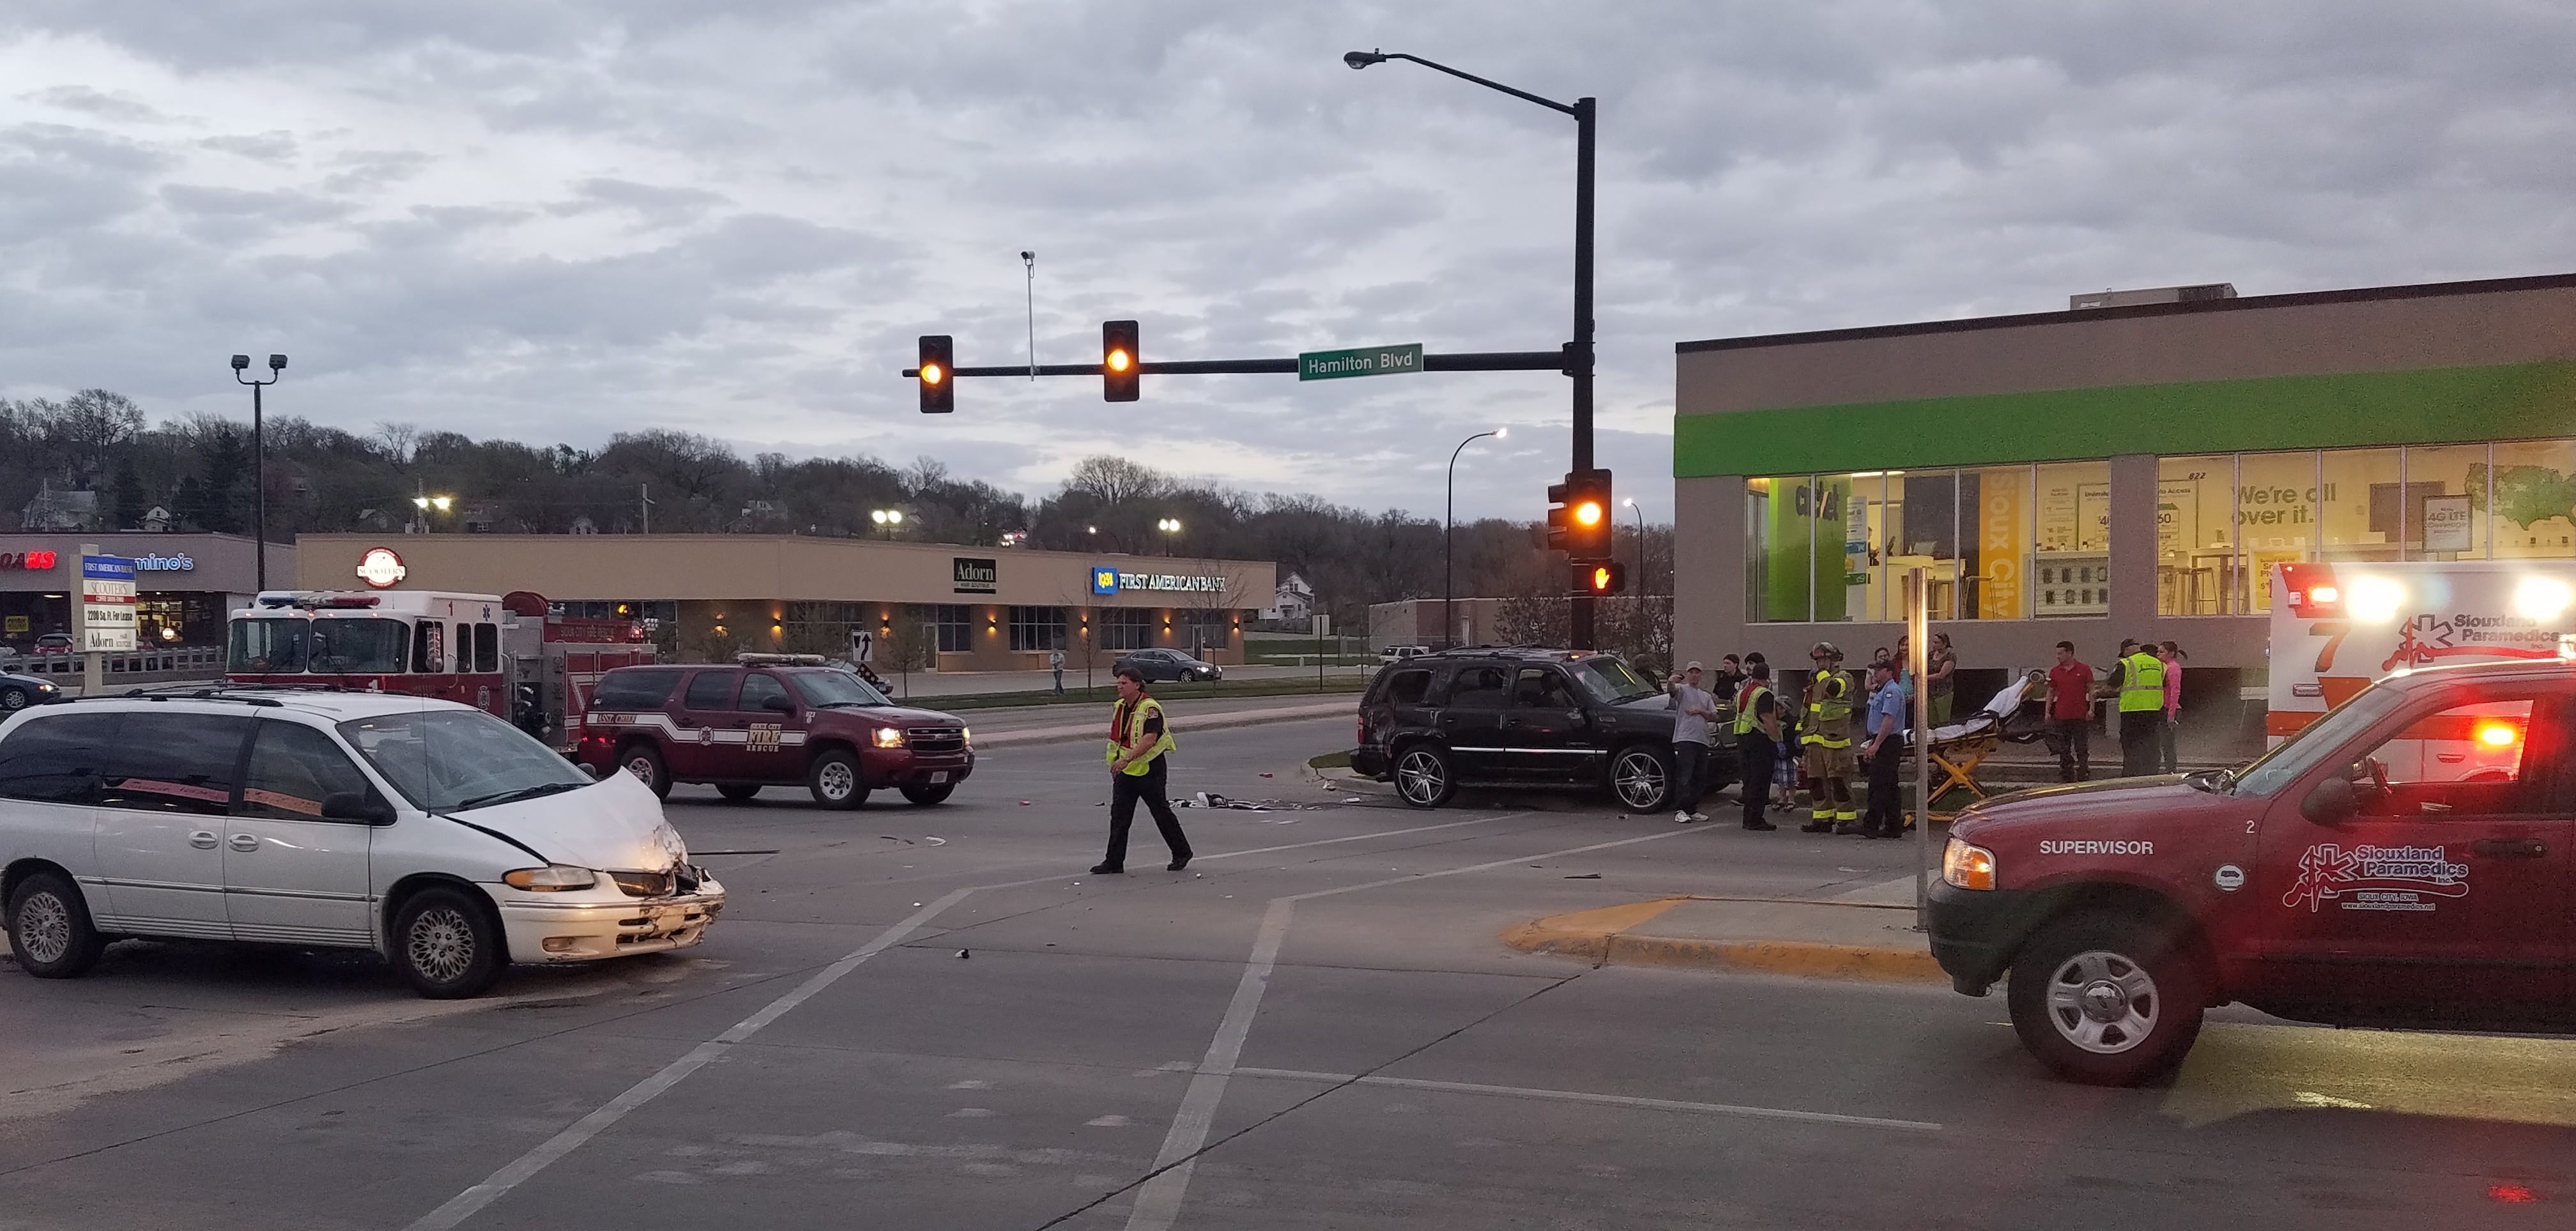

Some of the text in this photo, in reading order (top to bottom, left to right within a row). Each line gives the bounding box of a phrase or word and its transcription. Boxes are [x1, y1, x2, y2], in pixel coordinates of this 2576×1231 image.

[1308, 351, 1413, 374] Hamilton Blvd
[1795, 478, 1839, 521] crcket
[2231, 482, 2336, 505] We're all
[2231, 505, 2314, 525] over it.
[2428, 511, 2466, 521] 4G LTE
[956, 562, 993, 581] Adorn
[1118, 573, 1148, 590] FIRST
[1148, 574, 1200, 592] AMERICAN
[1200, 576, 1227, 592] BANK
[88, 609, 99, 621] 2200
[120, 611, 133, 621] Lease
[448, 600, 453, 616] 1
[89, 632, 114, 648] Adorn
[2462, 629, 2560, 641] Paramedics
[2309, 622, 2352, 673] 7
[747, 730, 780, 745] FIRE
[2245, 820, 2255, 834] 2
[2039, 840, 2154, 855] SUPERVISOR
[2356, 845, 2444, 862] Siouxland
[2365, 862, 2468, 877] Paramedics
[2342, 903, 2436, 911] www.siouxlandparamedics.net
